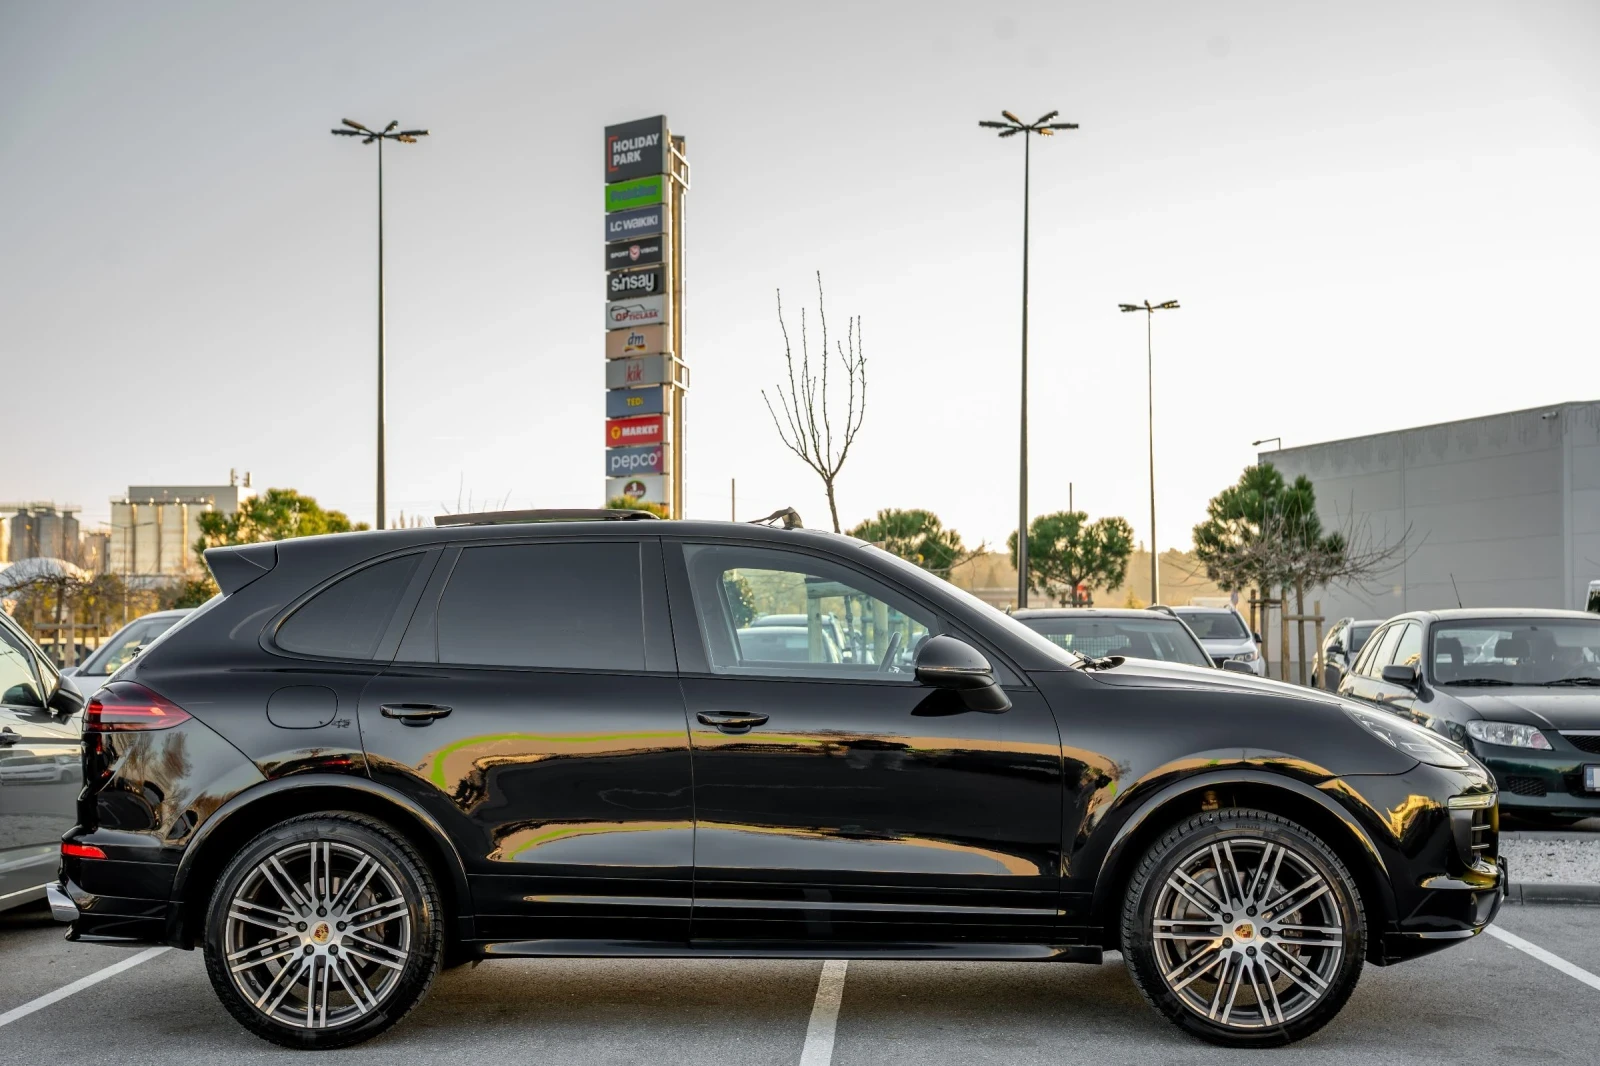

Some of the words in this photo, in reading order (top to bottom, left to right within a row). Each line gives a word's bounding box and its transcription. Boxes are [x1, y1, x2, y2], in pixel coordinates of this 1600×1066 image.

[613, 133, 659, 153] HOLIDAY
[613, 150, 641, 166] PARK
[610, 221, 622, 232] LC
[610, 251, 629, 259] SPORT
[611, 273, 655, 291] sinsay
[628, 332, 644, 345] dm
[622, 424, 659, 437] MARKET
[611, 453, 657, 471] pepco
[631, 483, 637, 491] 1
